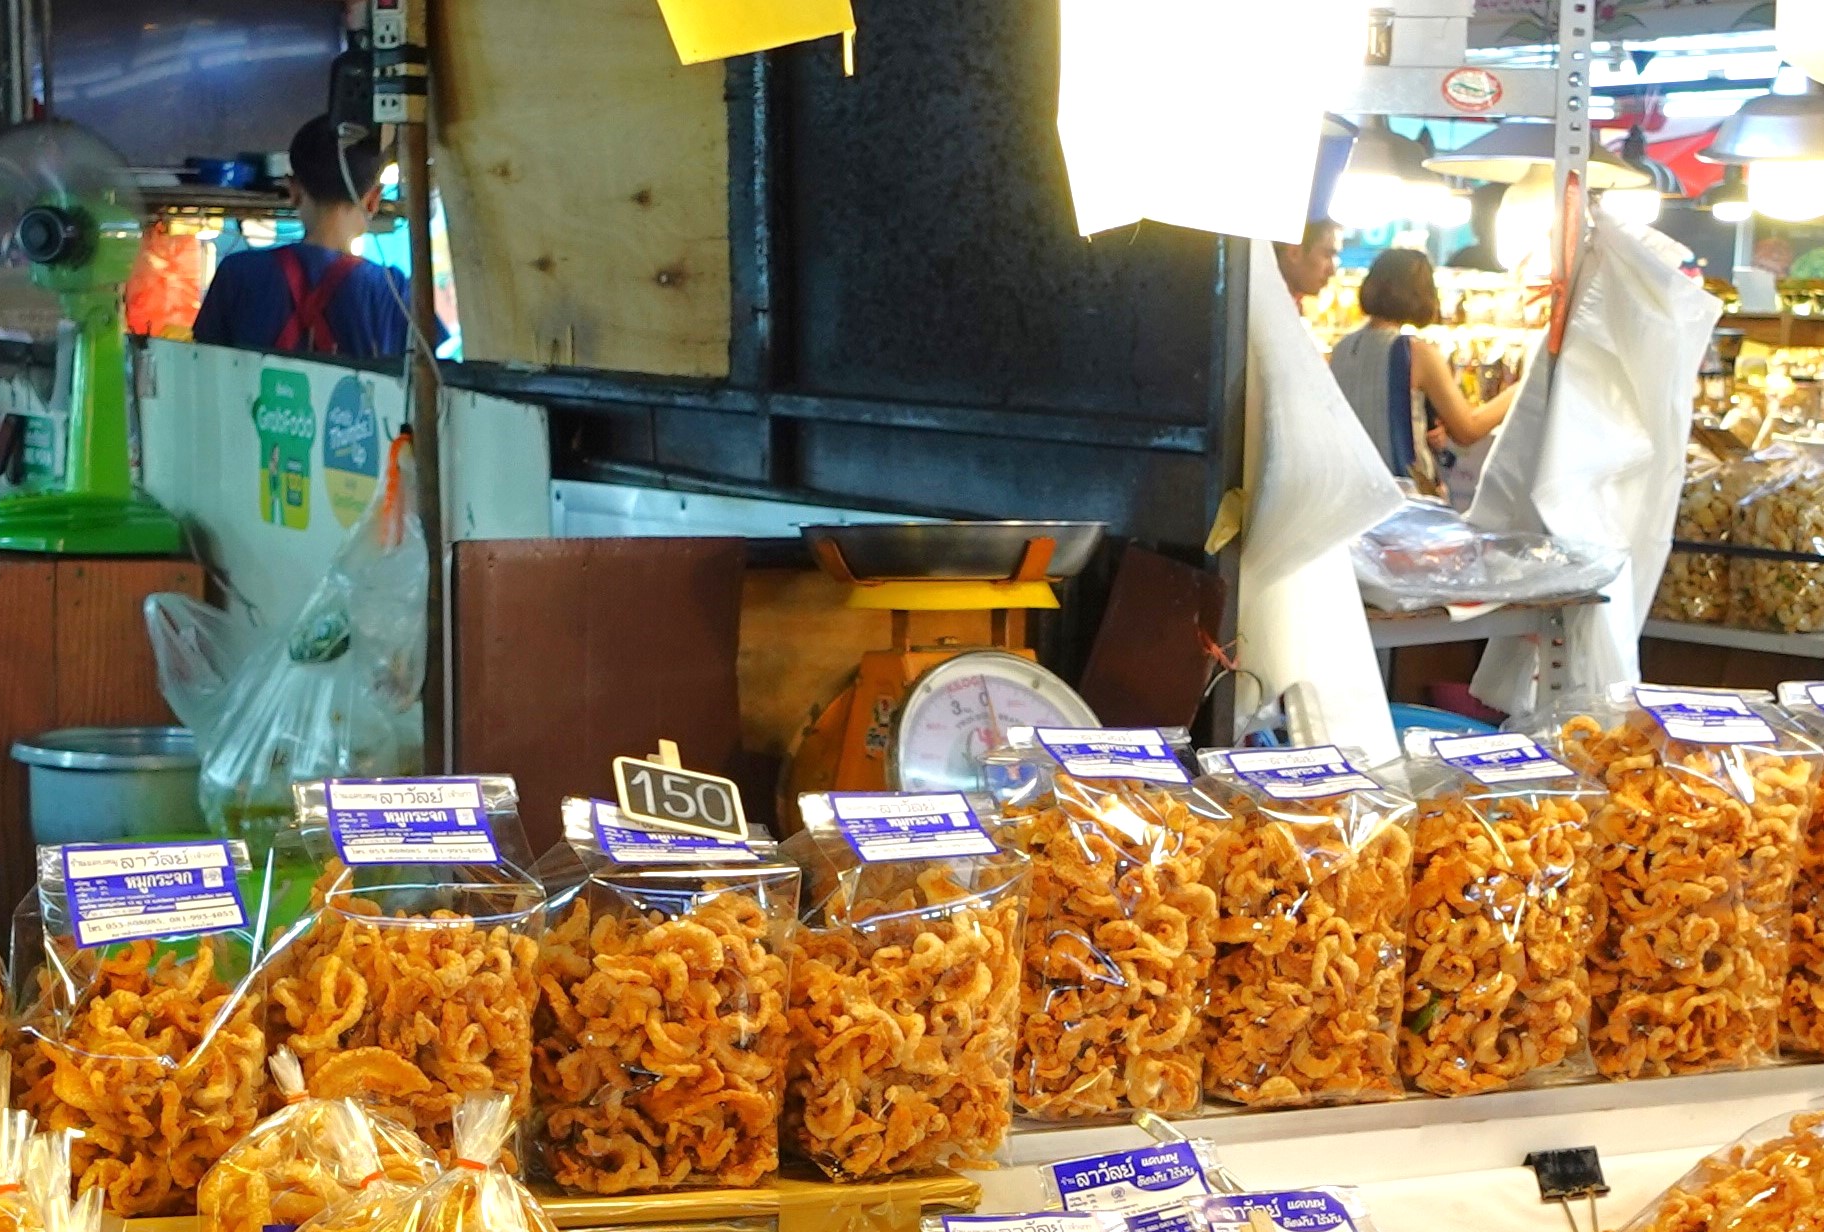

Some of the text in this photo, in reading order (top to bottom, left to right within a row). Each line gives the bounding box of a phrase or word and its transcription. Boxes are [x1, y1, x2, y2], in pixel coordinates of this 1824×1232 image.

[630, 769, 734, 828] 150
[120, 848, 190, 870] ลาวัลย์
[124, 871, 194, 893] หมูกระจก
[1075, 1156, 1136, 1188] ลาวัลย์
